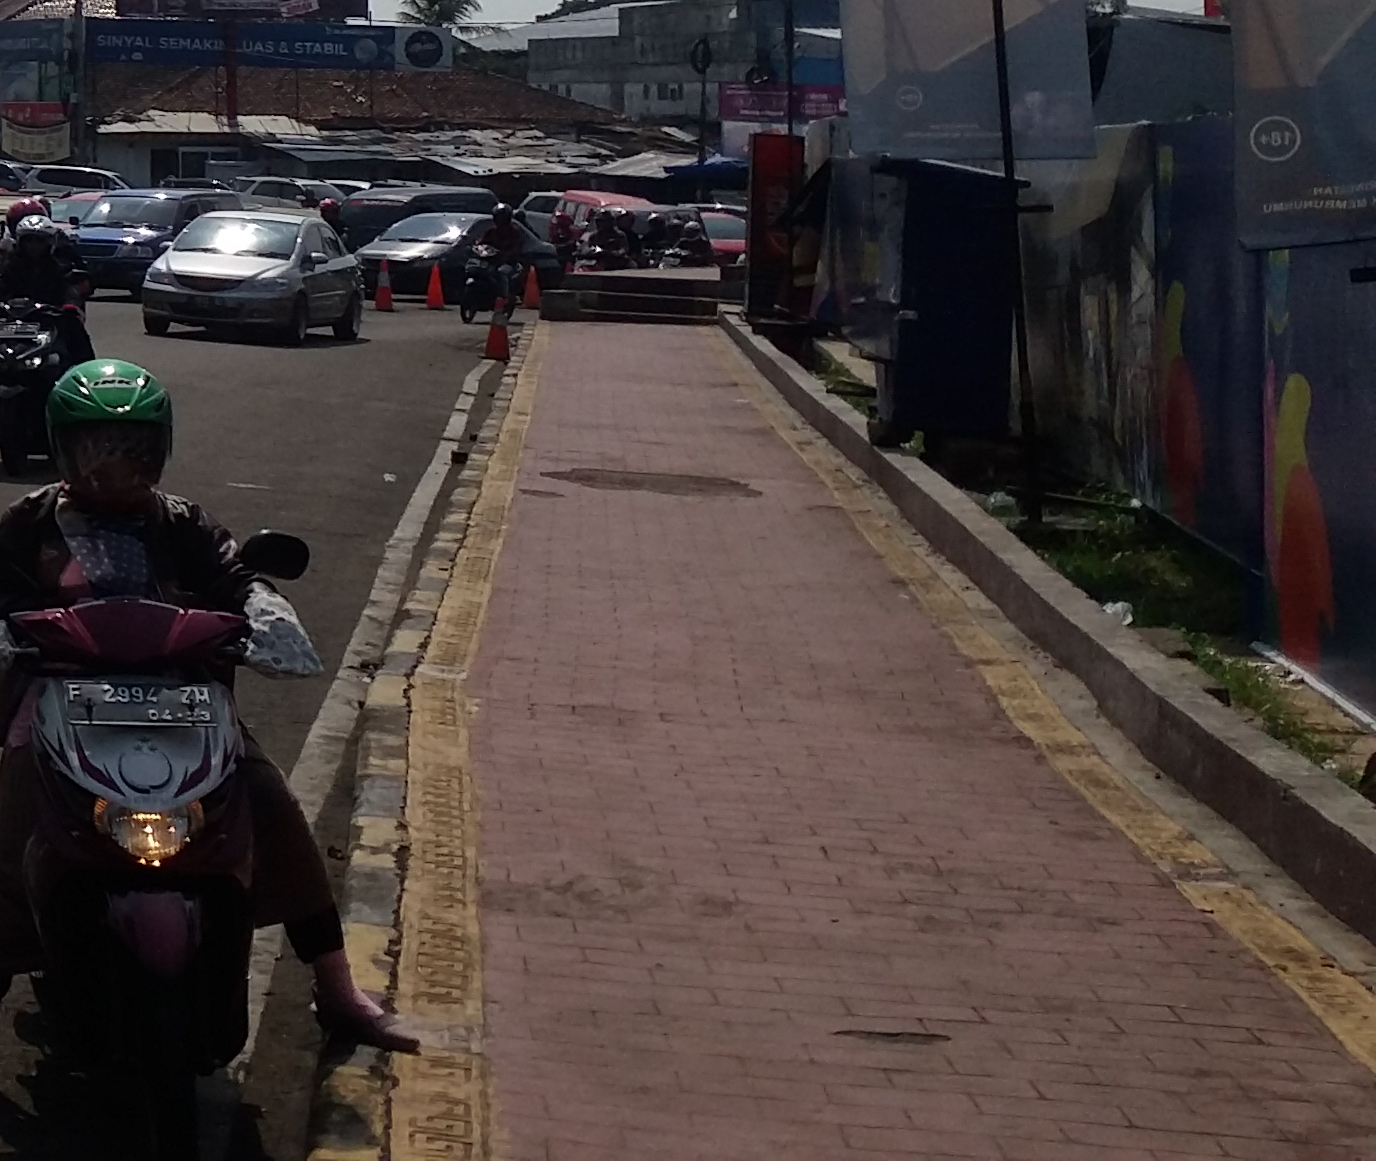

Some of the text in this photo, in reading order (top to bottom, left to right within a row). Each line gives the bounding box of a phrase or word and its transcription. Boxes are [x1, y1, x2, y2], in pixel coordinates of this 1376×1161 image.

[96, 34, 153, 48] SINYAL
[279, 41, 289, 54] &
[294, 42, 348, 55] STABIL
[93, 379, 132, 387] INK
[68, 684, 81, 701] F
[102, 684, 158, 703] 2994
